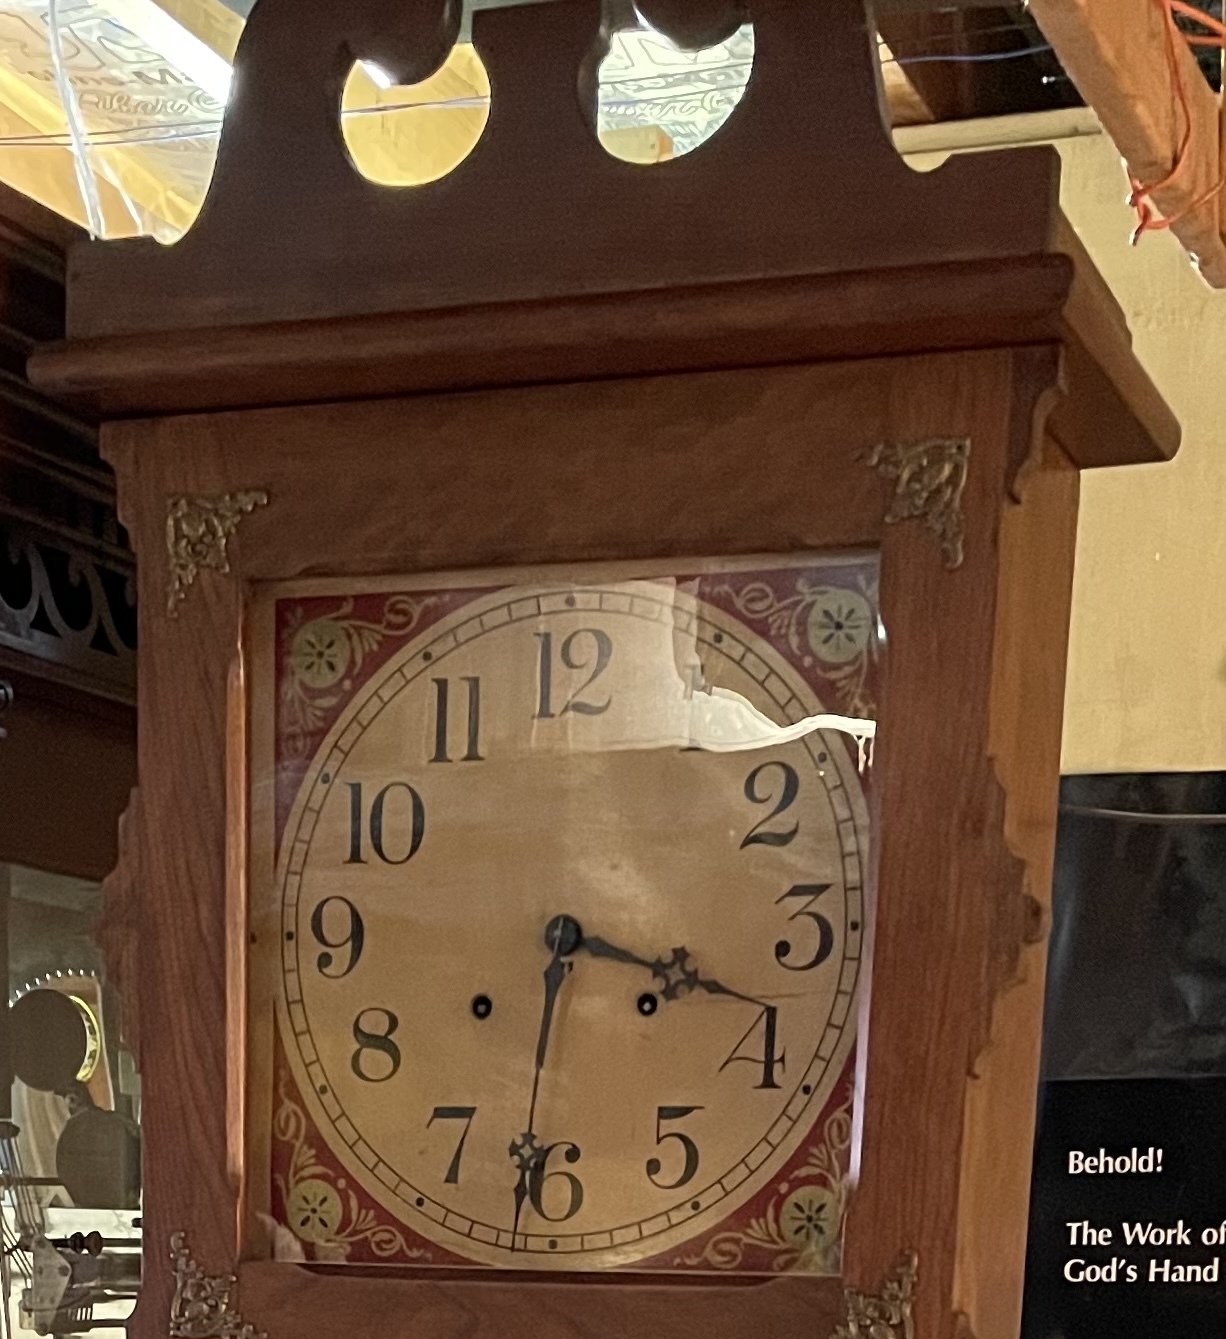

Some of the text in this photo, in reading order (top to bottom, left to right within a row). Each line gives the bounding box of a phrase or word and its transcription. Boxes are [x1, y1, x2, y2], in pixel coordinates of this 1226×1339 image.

[532, 627, 614, 719] 12
[427, 674, 486, 764] 11
[343, 780, 426, 865] 10
[739, 760, 800, 849] 2
[310, 895, 364, 979] 9
[773, 882, 834, 971] 3
[350, 1007, 401, 1083] 8
[718, 1004, 787, 1090] 4
[426, 1105, 477, 1184] 7
[529, 1141, 584, 1222] 6
[645, 1105, 705, 1189] 5
[1068, 1147, 1163, 1174] Behold!
[1063, 1257, 1219, 1283] God's Hand
[1066, 1219, 1226, 1246] The Work of
